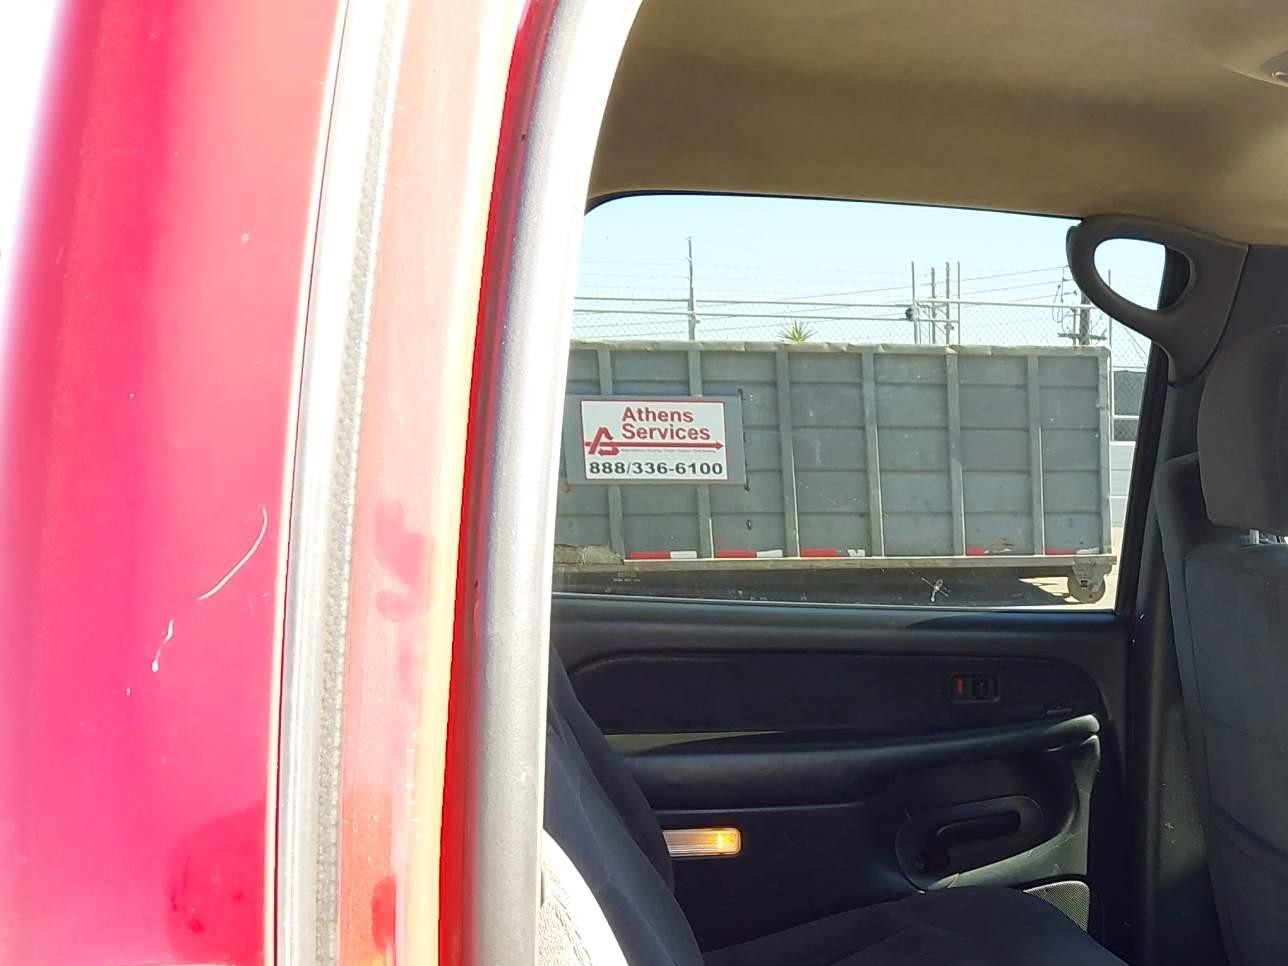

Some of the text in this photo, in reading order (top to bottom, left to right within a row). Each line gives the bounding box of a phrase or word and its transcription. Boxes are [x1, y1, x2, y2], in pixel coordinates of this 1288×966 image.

[622, 406, 694, 423] Athens
[622, 423, 710, 441] Services
[589, 461, 723, 475] 888/336-6100
